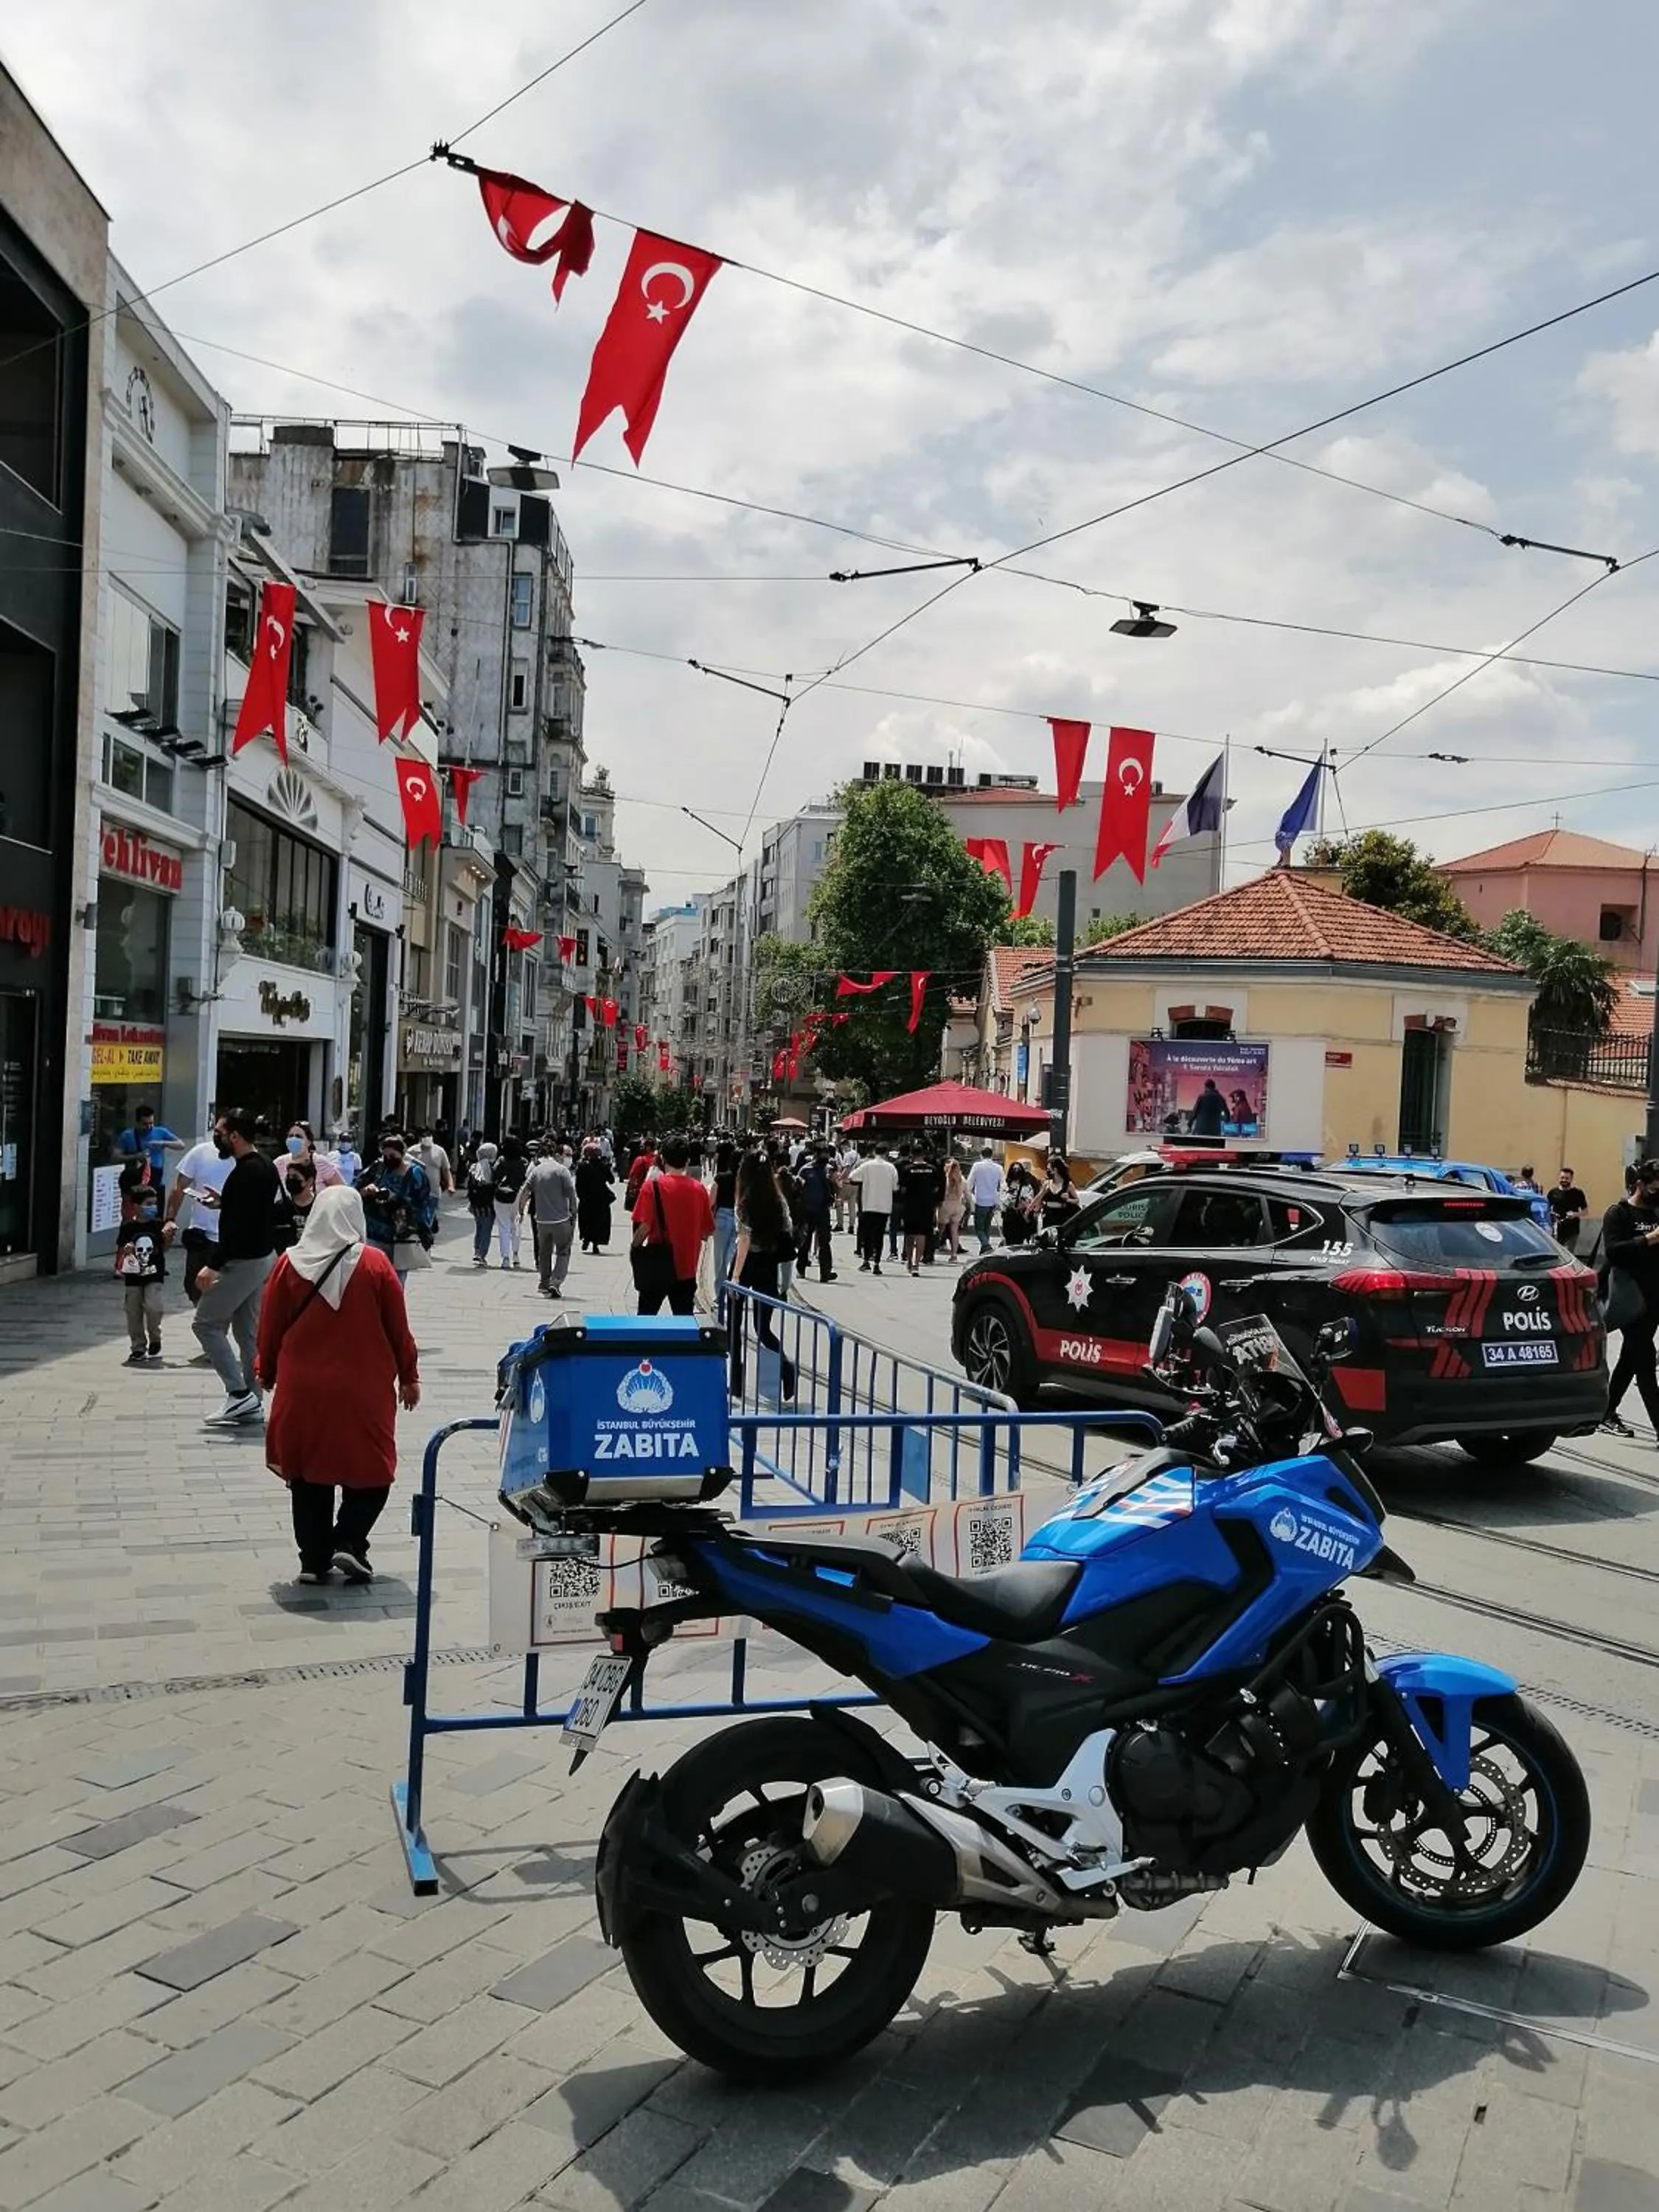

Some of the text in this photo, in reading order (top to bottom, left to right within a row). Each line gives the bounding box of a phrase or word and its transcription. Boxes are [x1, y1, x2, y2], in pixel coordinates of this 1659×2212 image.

[100, 824, 181, 889] ehlivan
[1321, 1239, 1354, 1256] 155
[1503, 1306, 1552, 1331] POLİS
[1060, 1337, 1102, 1363] POLİS
[1489, 1347, 1505, 1361] 34
[1508, 1347, 1517, 1360] A
[597, 1418, 696, 1430] İSTANBUL BÜYÜKŞEHİR
[594, 1433, 700, 1459] ZABITA
[1294, 1526, 1354, 1570] ZABITA
[583, 1663, 604, 1690] 34
